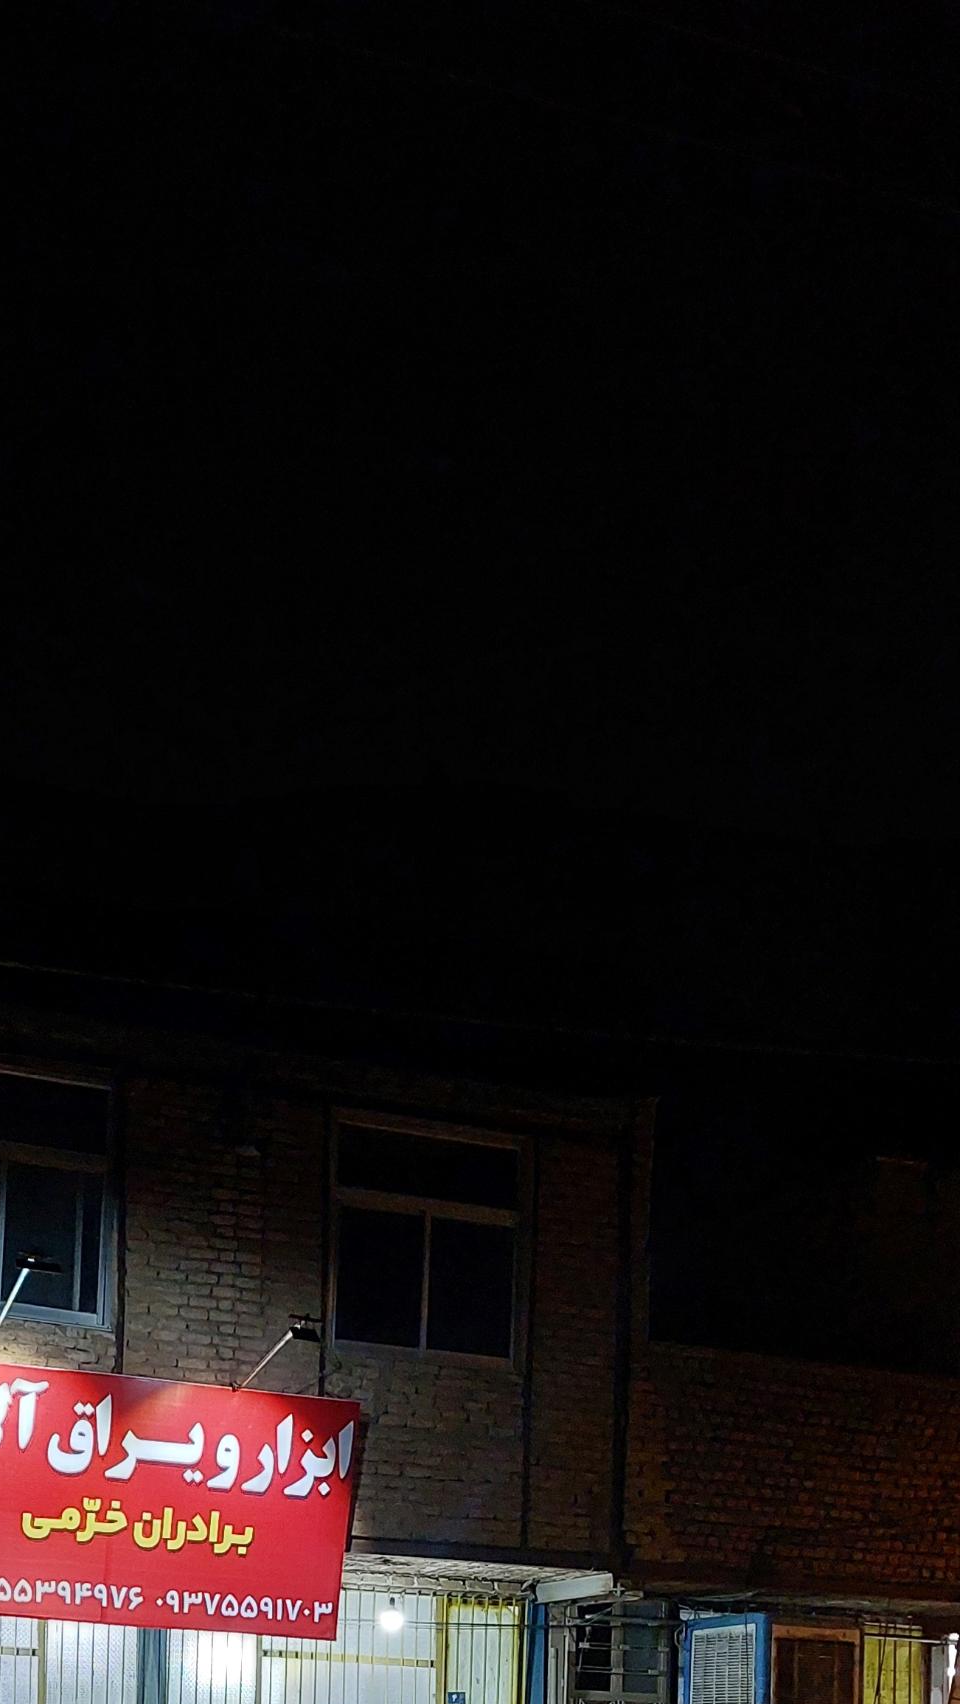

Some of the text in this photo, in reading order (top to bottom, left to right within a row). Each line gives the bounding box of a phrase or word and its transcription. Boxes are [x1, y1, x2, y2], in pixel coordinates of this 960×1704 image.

[241, 1413, 355, 1497] ابزار
[133, 1506, 254, 1555] برادران
[155, 1589, 334, 1623] ۰۹۳۷۵۵۹۱۷۰۳
